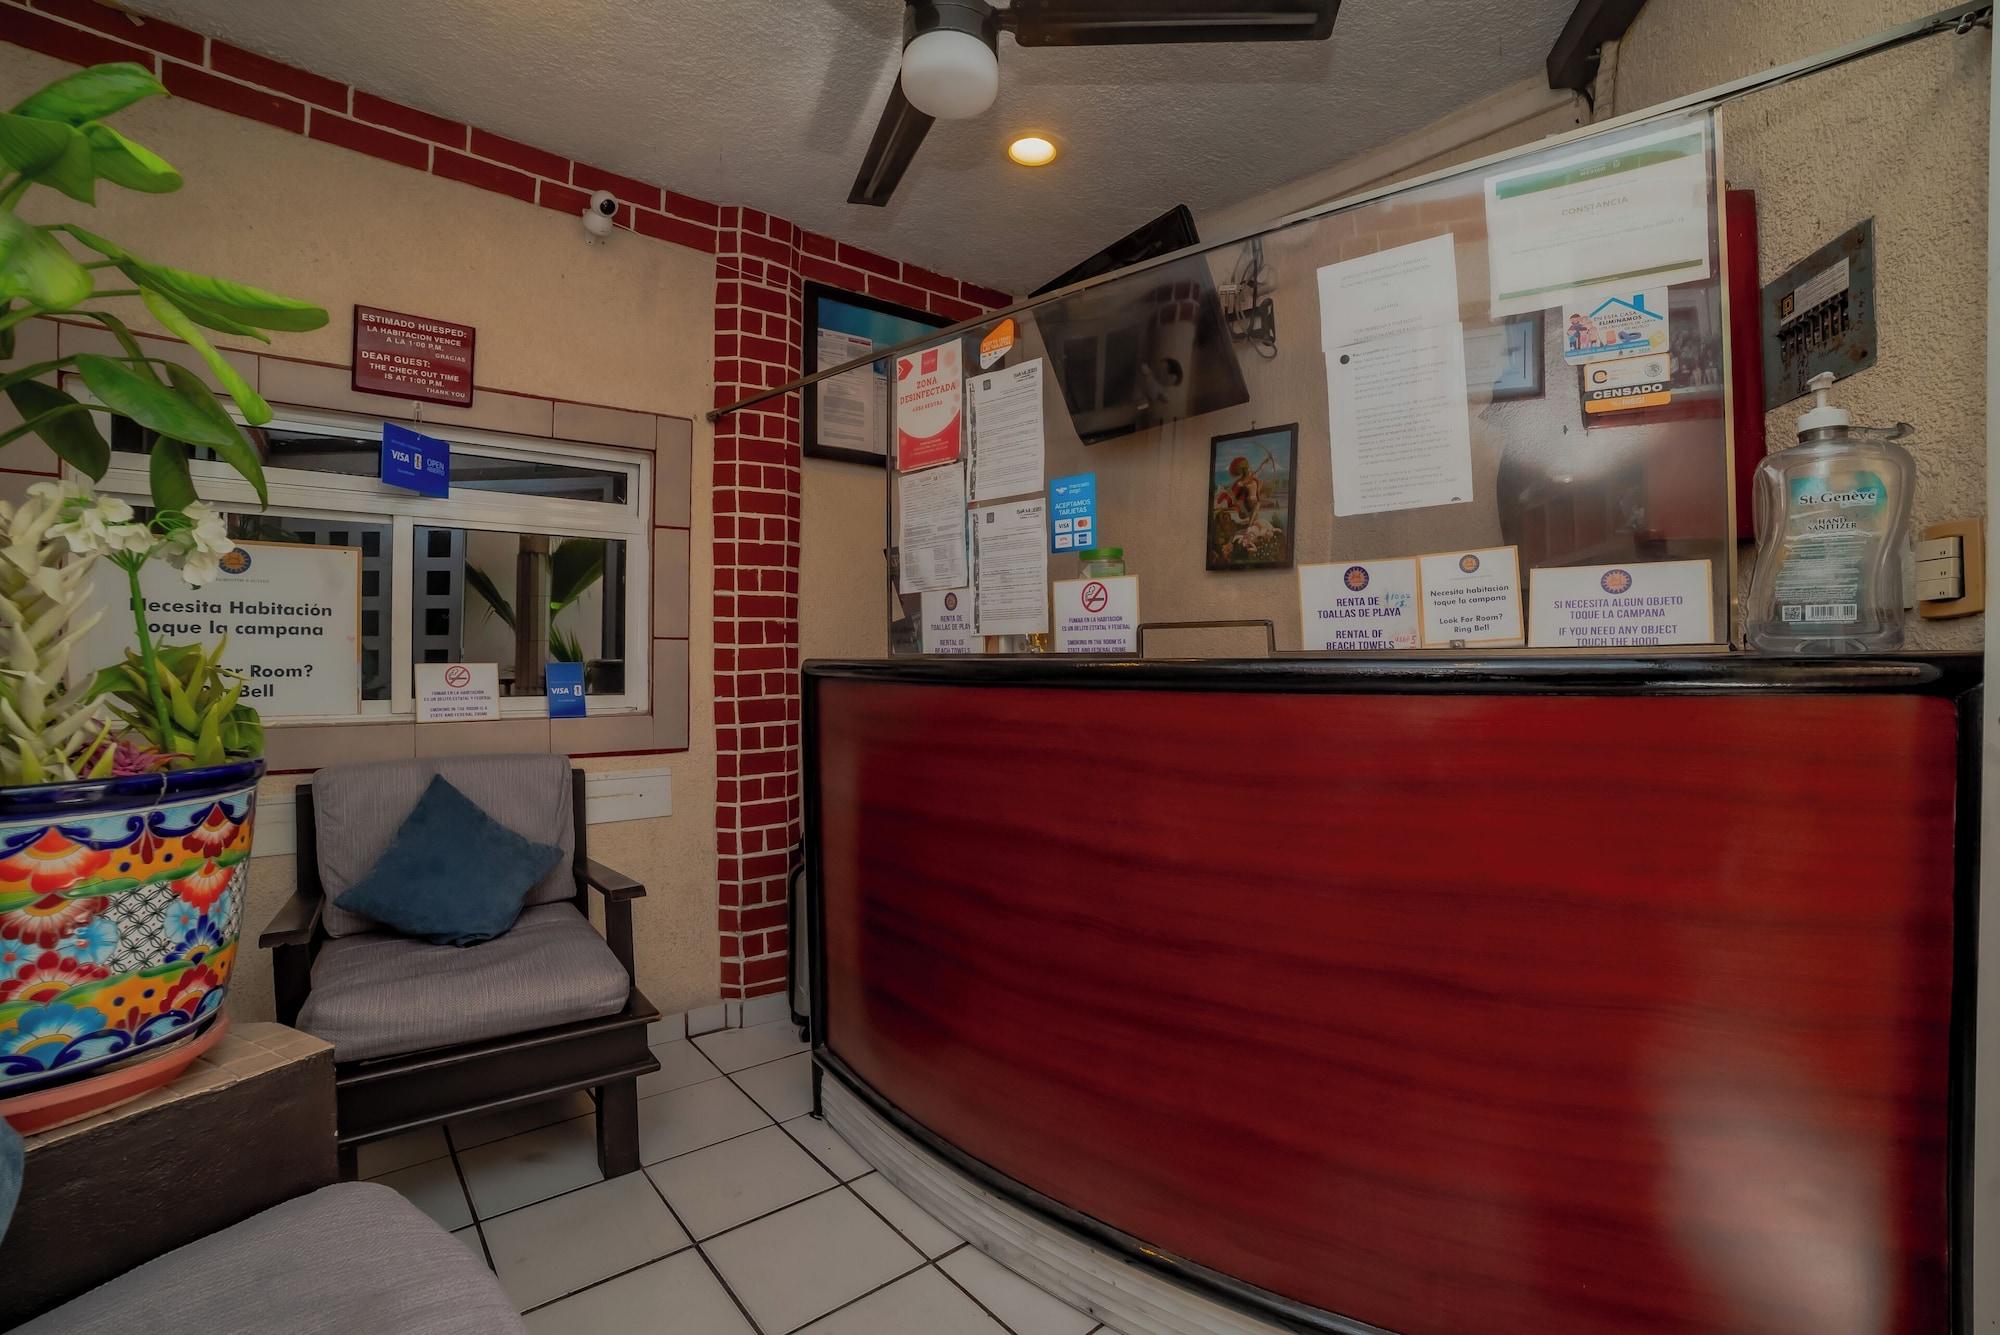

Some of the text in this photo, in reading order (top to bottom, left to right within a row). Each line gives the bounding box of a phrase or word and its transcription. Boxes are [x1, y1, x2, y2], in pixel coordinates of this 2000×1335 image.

[1562, 196, 1628, 216] CONSTANCIA
[362, 314, 467, 338] ESTIMADO HUESPED:
[380, 328, 432, 341] HABITACION
[434, 336, 461, 346] VENCE
[409, 340, 426, 348] 1:00
[428, 343, 444, 352] P.M.
[362, 351, 430, 368] DEAR GUEST:
[435, 353, 466, 362] GRACIAS
[370, 362, 386, 370] THE
[389, 366, 418, 376] CHECK
[440, 373, 460, 382] TIME
[916, 376, 937, 389] ZONA
[426, 388, 448, 396] THANK
[900, 382, 956, 404] DESINFECTADA
[1592, 384, 1662, 400] CENSADO
[391, 450, 410, 463] VISA
[427, 458, 444, 470] OPEN
[1800, 490, 1876, 504] St. Genève
[1056, 499, 1090, 510] ACEPTAMOS
[1059, 506, 1087, 515] TARJETAS
[1808, 522, 1856, 530] SANITIZER
[1430, 588, 1464, 596] Necesita
[1336, 597, 1380, 606] RENTA DE
[1554, 596, 1683, 608] SI NECESITA ALGUN OBJETO
[230, 601, 332, 617] Habitación
[1318, 608, 1400, 618] TOALLAS DE PLAYA
[1571, 609, 1665, 620] TOQUE LA CAMPANA
[1476, 614, 1502, 622] Room?
[148, 620, 323, 638] oque la campana
[1336, 630, 1382, 638] RENTAL OF
[1559, 624, 1677, 636] IF YOU NEED ANY OBJECT
[1326, 641, 1394, 650] BEACH TOWELS
[1576, 637, 1658, 646] TOUCH THE HOOD
[250, 664, 313, 678] Room?
[240, 684, 274, 697] Bell
